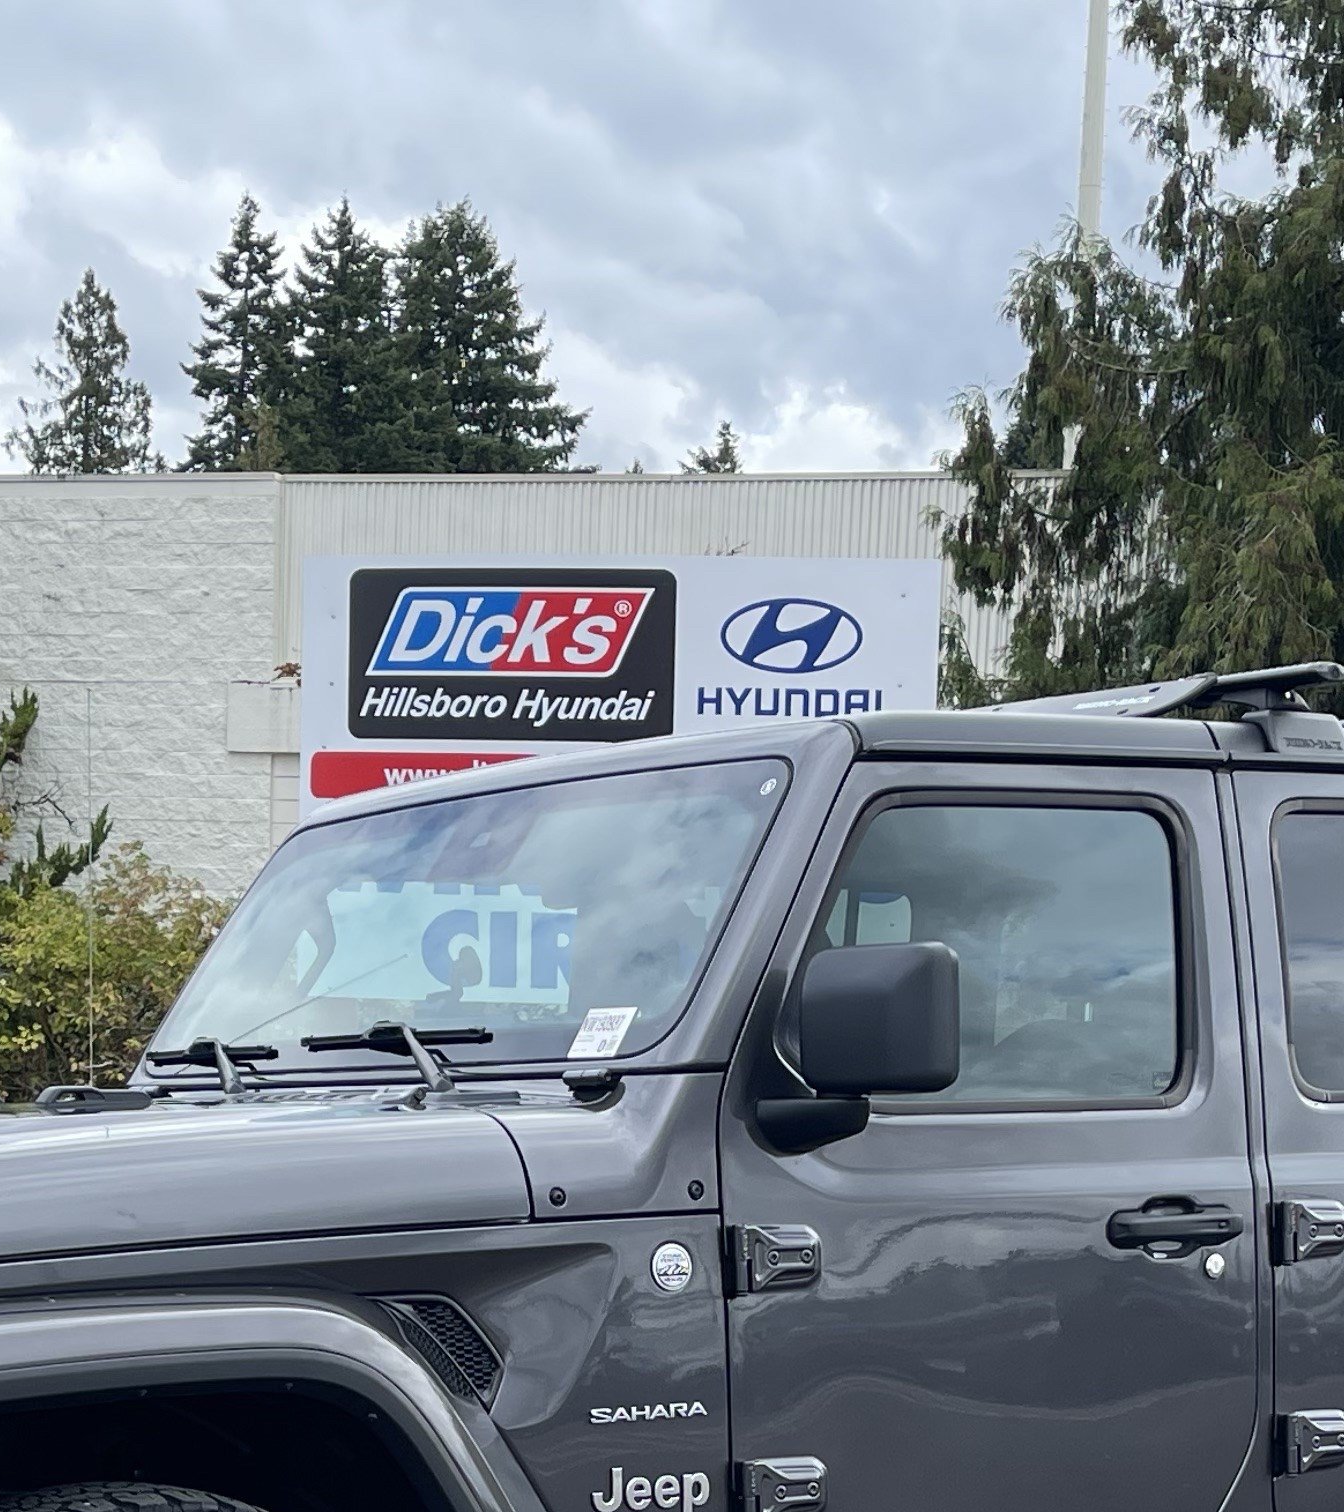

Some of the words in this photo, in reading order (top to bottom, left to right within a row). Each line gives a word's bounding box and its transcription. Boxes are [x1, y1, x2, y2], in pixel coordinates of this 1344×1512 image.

[359, 686, 508, 718] Hillsboro
[512, 688, 656, 727] Hyundai
[697, 686, 883, 718] HYUNDAI
[590, 1401, 708, 1424] SAHARA
